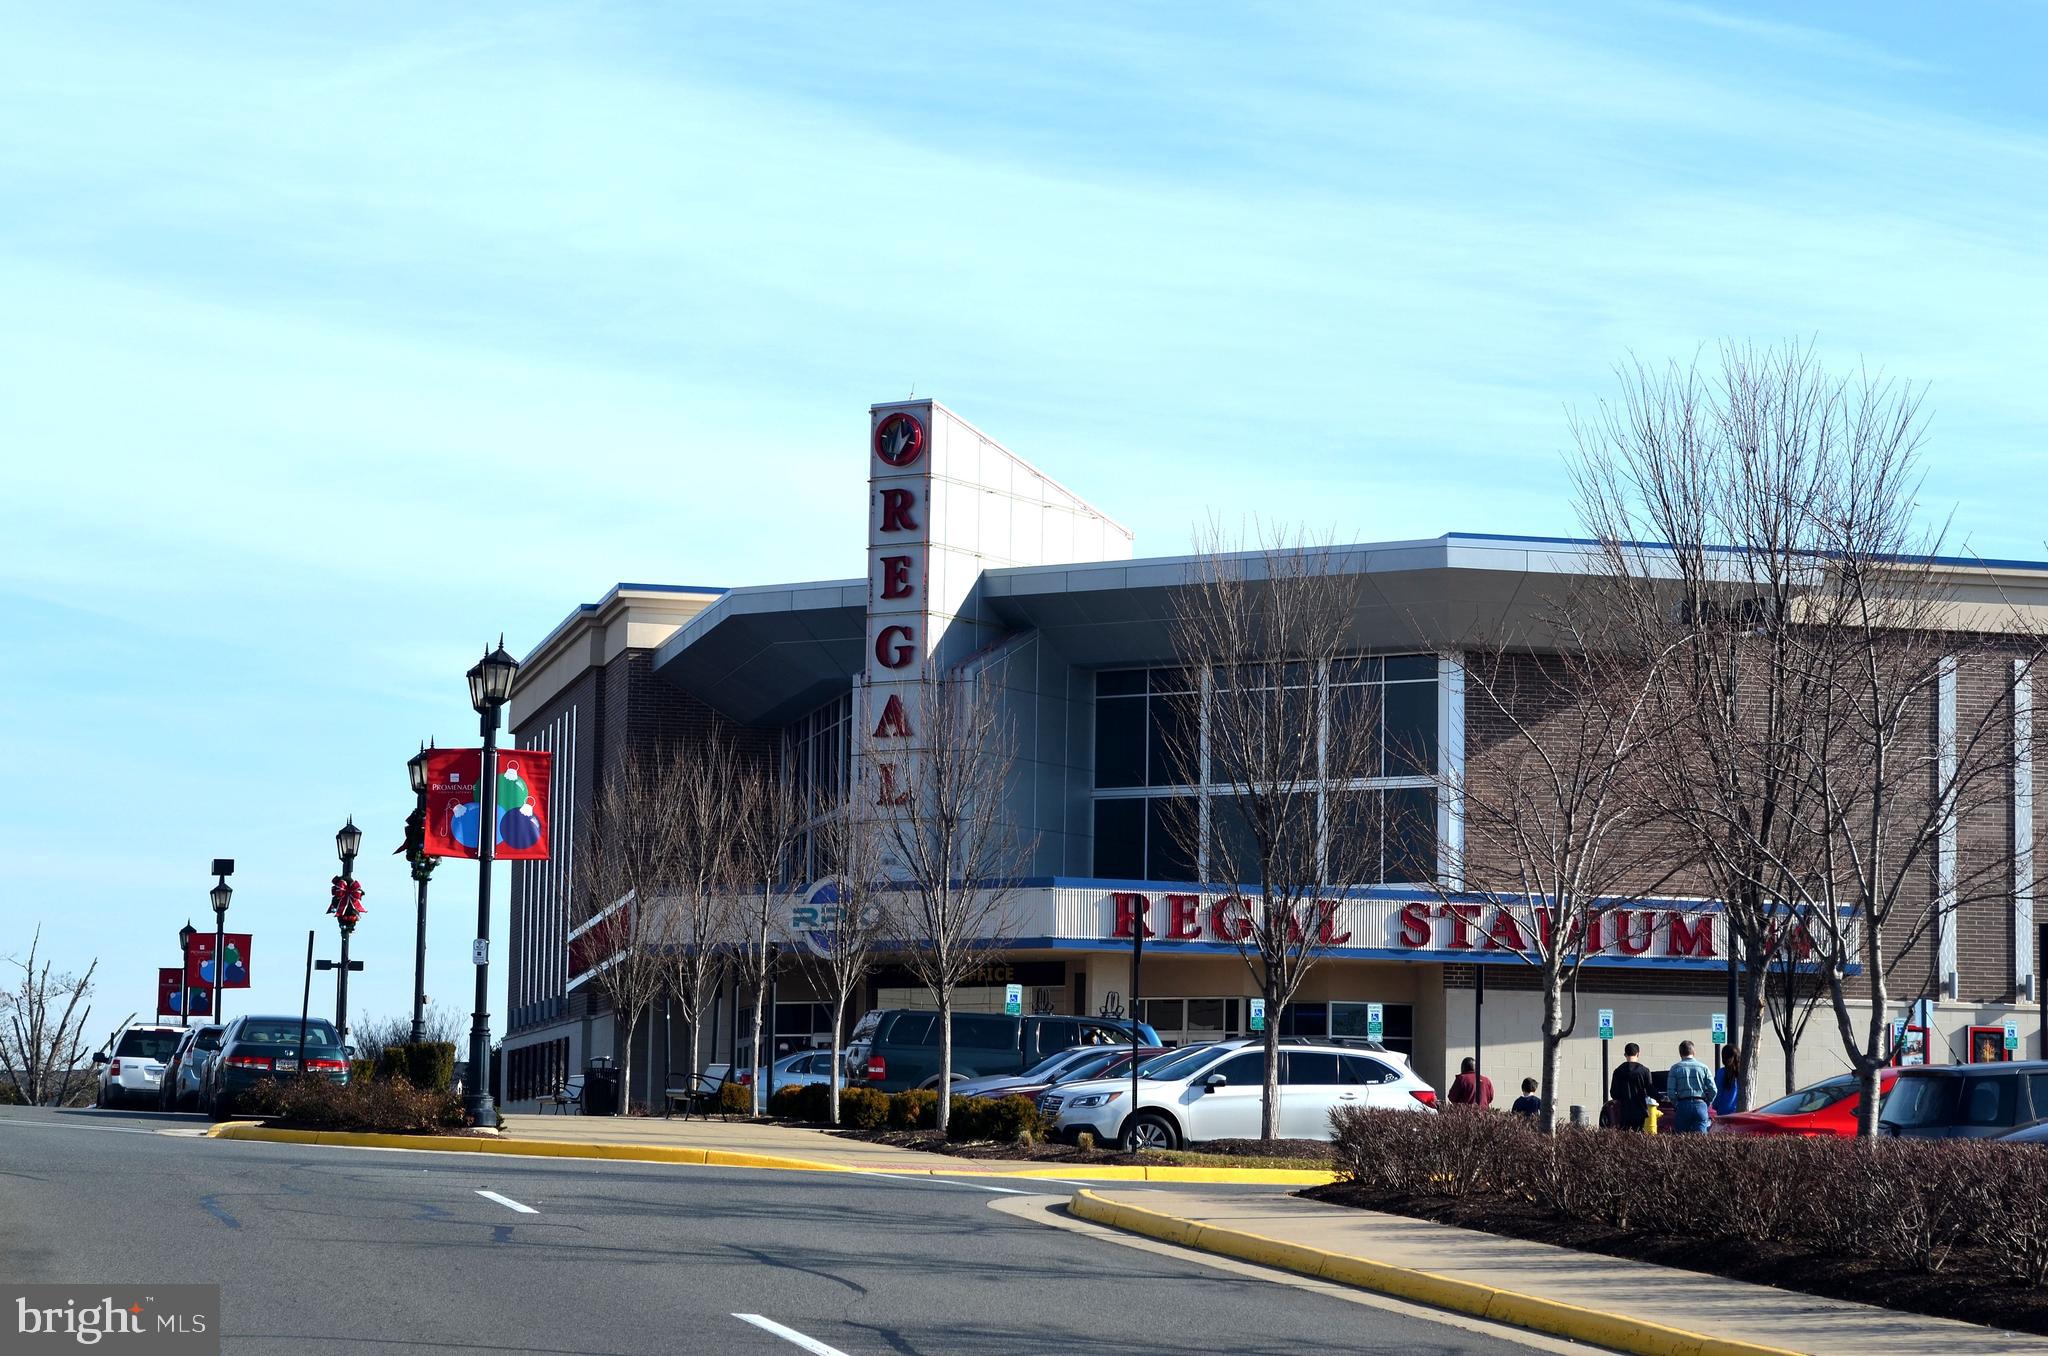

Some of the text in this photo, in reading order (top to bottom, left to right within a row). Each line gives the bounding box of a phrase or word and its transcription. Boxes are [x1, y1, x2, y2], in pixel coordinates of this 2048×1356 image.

[872, 488, 918, 806] REGAL
[432, 783, 477, 791] PROMENADE
[1112, 892, 1352, 946] REGAL
[1400, 902, 1718, 957] STADIUM
